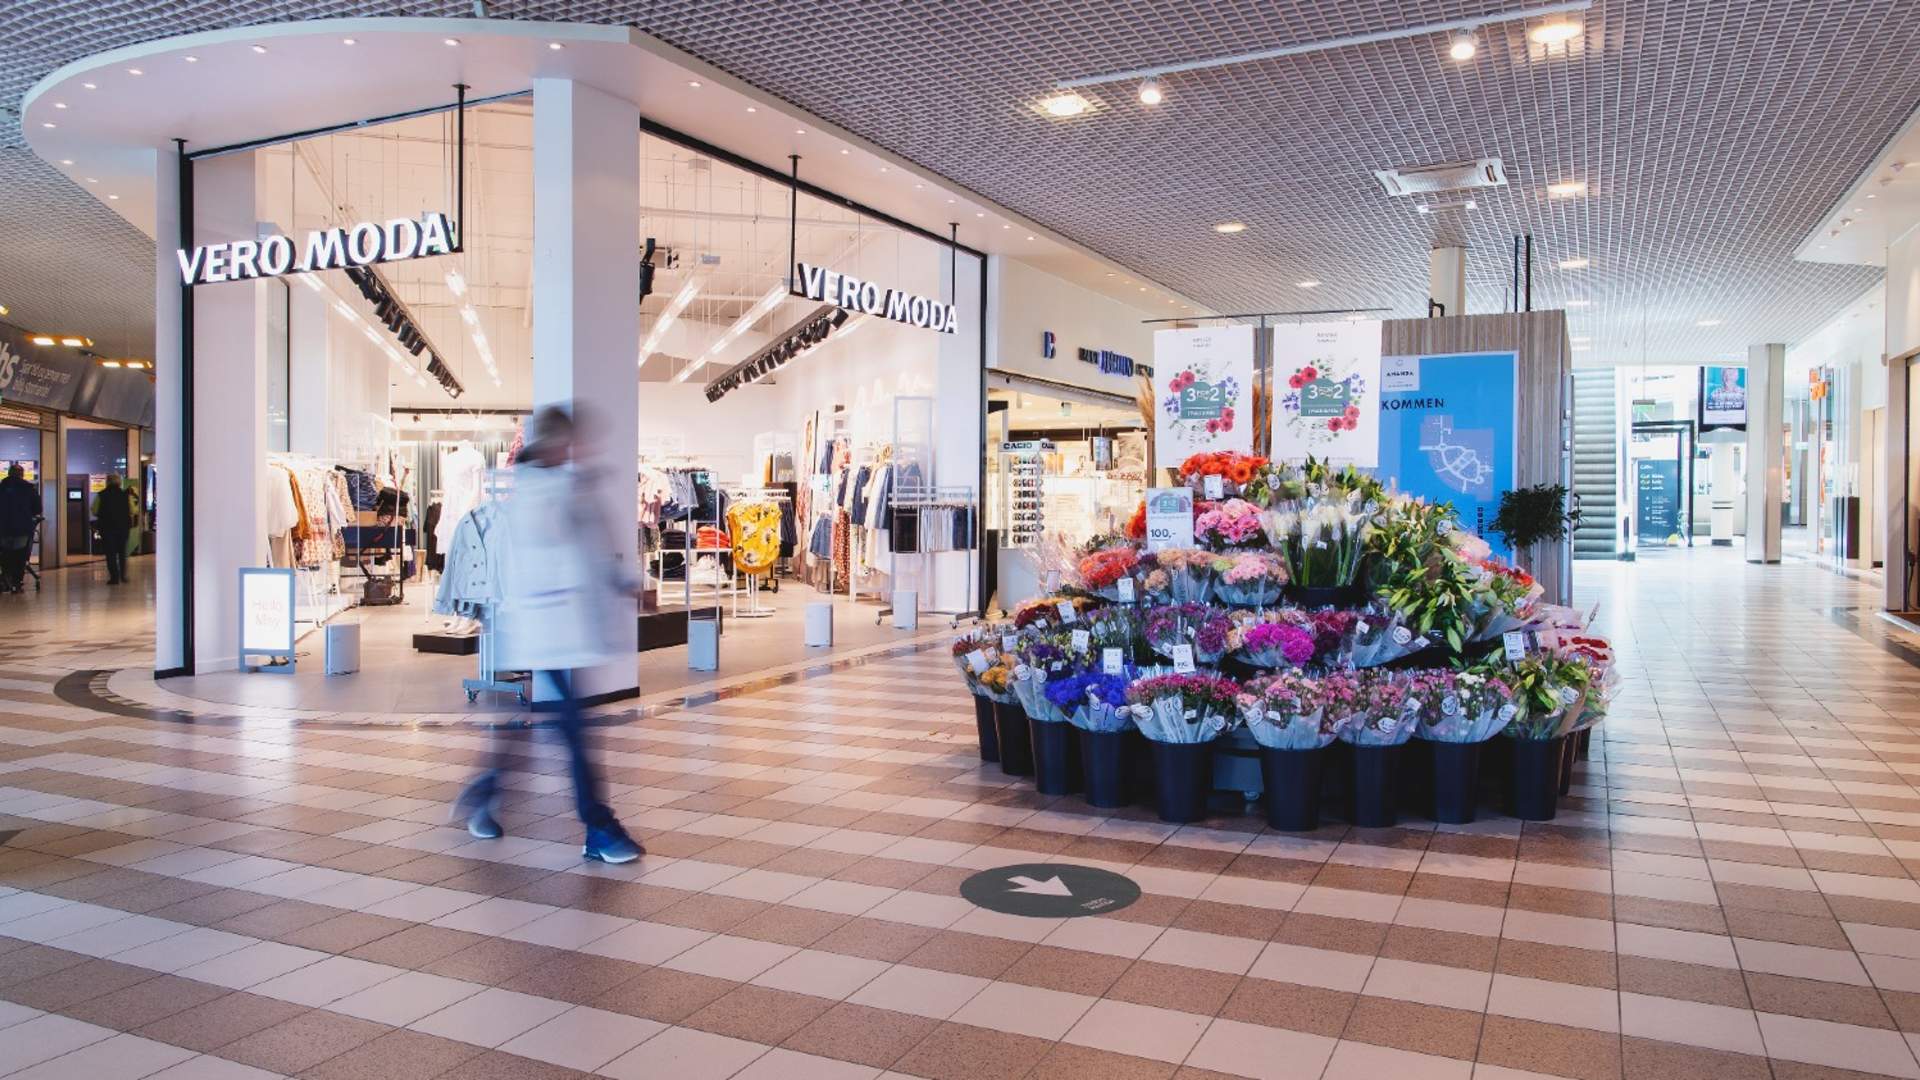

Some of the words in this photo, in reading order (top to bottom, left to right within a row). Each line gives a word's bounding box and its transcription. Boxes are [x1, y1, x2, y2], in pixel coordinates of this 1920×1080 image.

[176, 235, 294, 285] VERO
[302, 213, 453, 272] MODA
[799, 263, 881, 315] VERO
[886, 289, 959, 335] MODA
[1186, 387, 1197, 402] 3
[1209, 387, 1220, 402] 2
[1307, 384, 1318, 400] 3
[1332, 383, 1344, 400] 2
[1381, 398, 1445, 411] KOMMEN
[1150, 528, 1176, 539] 100,-
